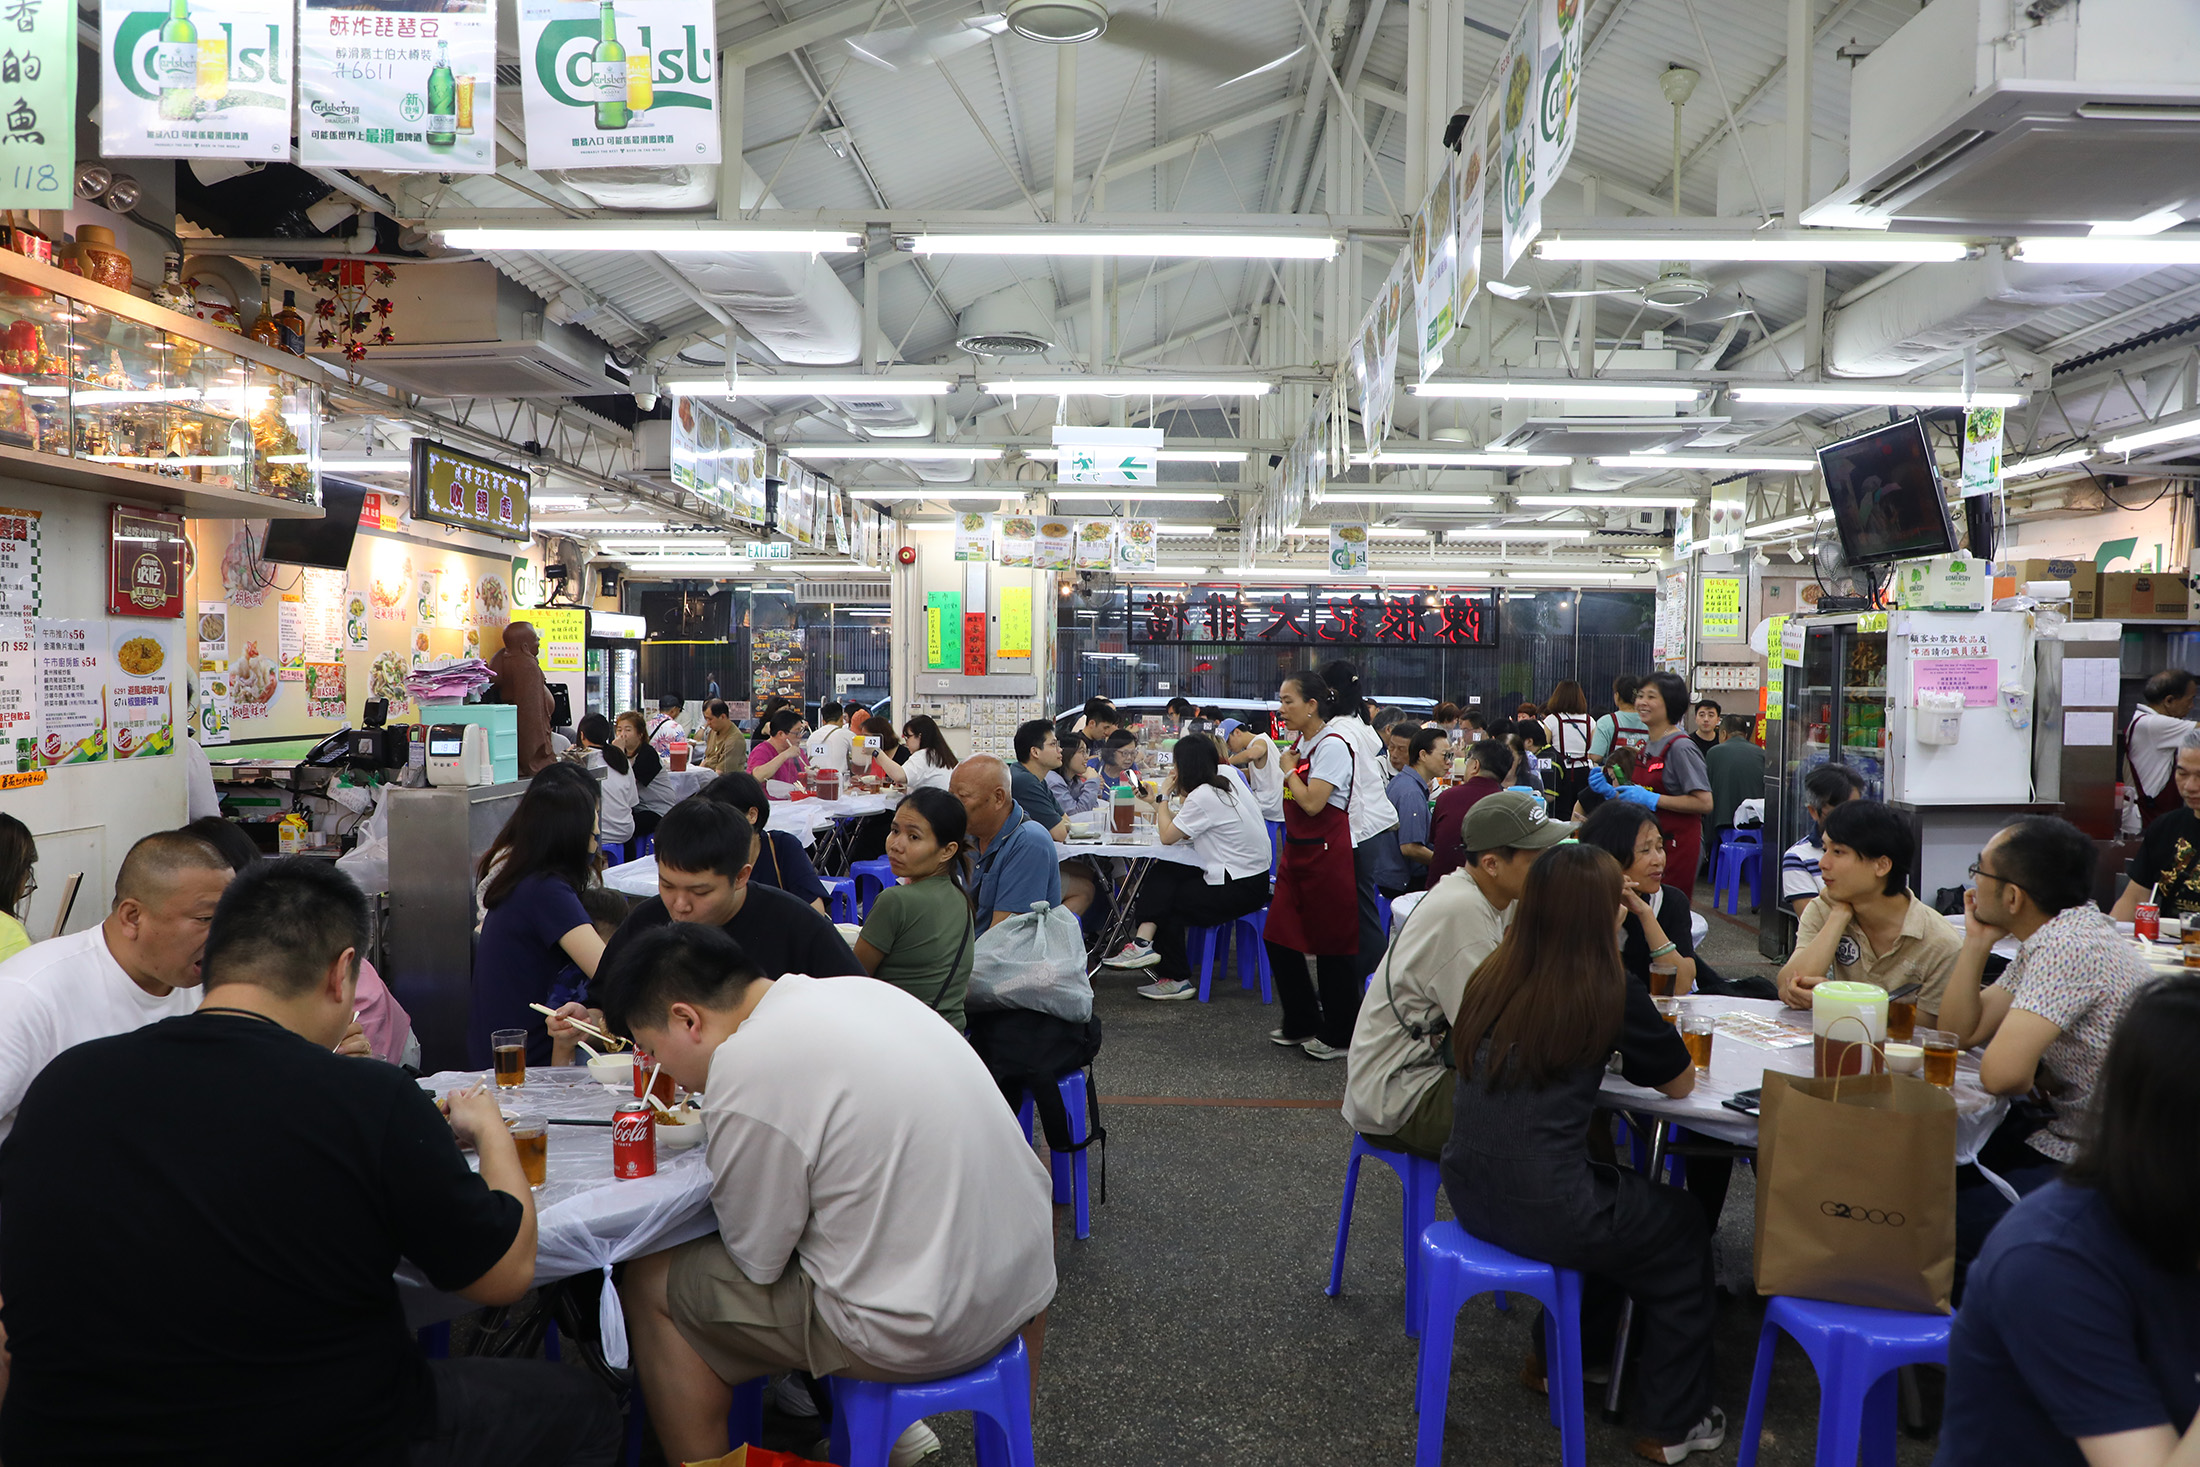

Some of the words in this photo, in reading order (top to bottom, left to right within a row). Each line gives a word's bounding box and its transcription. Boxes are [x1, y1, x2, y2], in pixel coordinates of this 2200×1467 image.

[329, 15, 439, 38] 酥炸琵琶豆
[159, 54, 197, 69] Carlsber
[593, 71, 627, 88] Carlsber
[405, 92, 418, 105] 新
[310, 100, 351, 115] Carlsberg
[450, 481, 513, 522] 收銀處
[1, 542, 16, 552] $54
[748, 543, 769, 558] EXIT
[770, 543, 789, 558] 出口
[137, 566, 161, 585] 必吃
[2047, 566, 2077, 575] Merries
[69, 629, 85, 639] $56
[1910, 634, 1987, 644] 顧客如需取飲品及
[13, 641, 28, 651] $52
[1911, 645, 1988, 656] 啤酒請向職員落單
[82, 657, 96, 667] $54
[317, 687, 339, 697] WASABI
[1158, 753, 1169, 762] 25
[1539, 760, 1549, 769] 15
[1820, 1201, 1905, 1227] G2000
